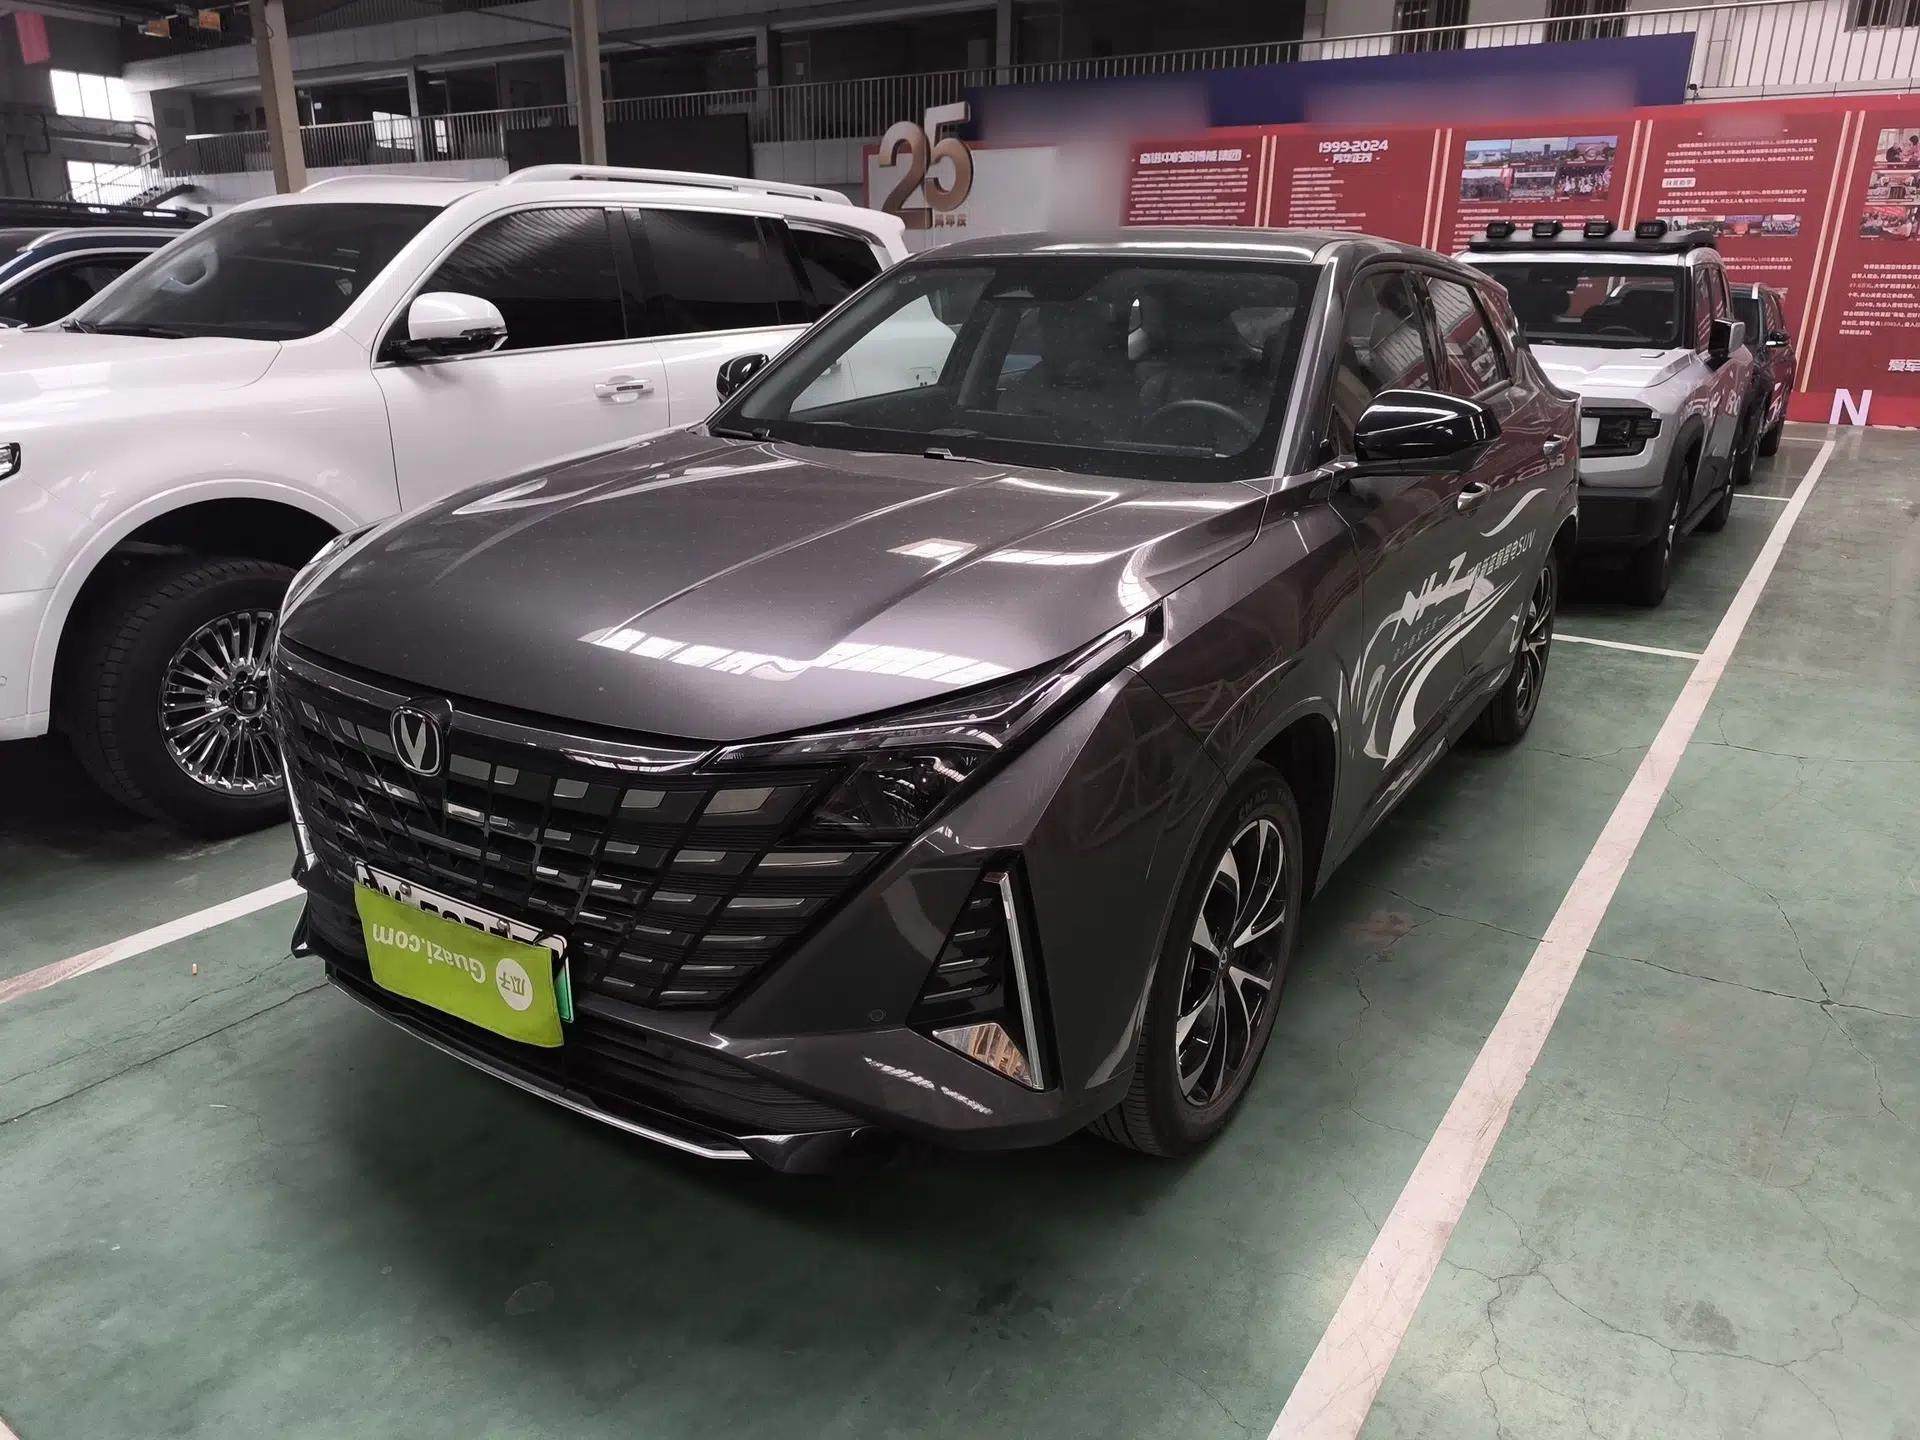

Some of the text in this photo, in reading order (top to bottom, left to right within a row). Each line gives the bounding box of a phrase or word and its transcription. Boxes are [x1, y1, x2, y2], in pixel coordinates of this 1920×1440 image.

[878, 101, 974, 230] 25
[1319, 139, 1389, 153] 1999-2024
[1829, 388, 1873, 427] N
[373, 922, 526, 996] 瓜子 Guazi.com
